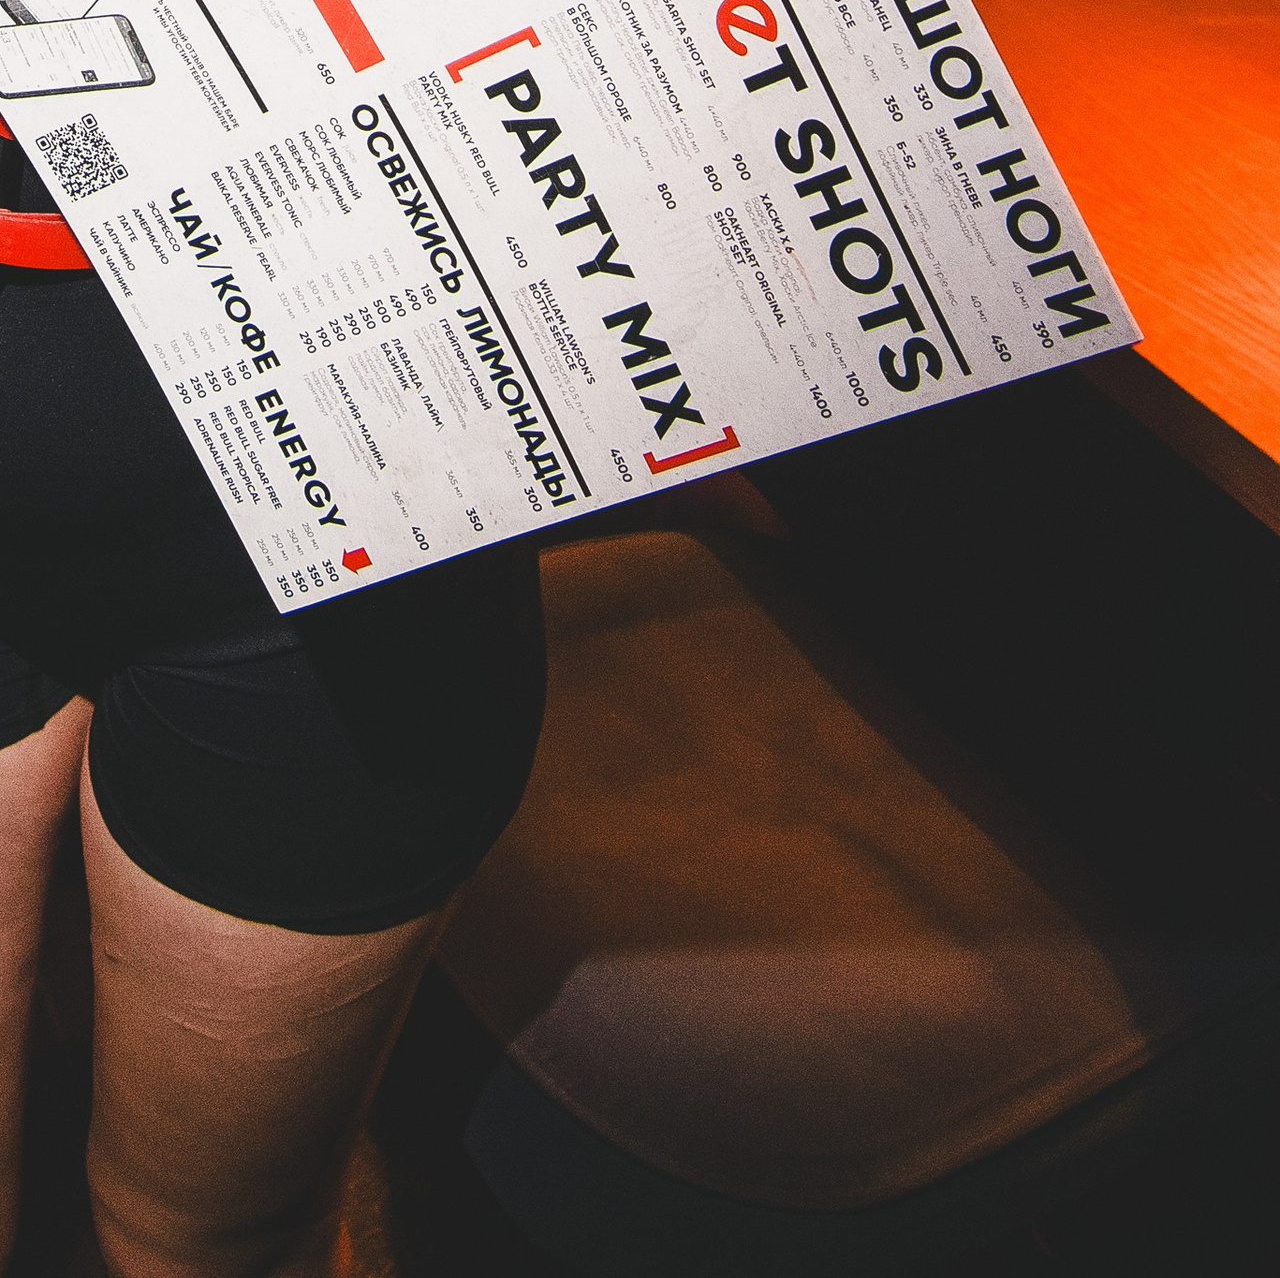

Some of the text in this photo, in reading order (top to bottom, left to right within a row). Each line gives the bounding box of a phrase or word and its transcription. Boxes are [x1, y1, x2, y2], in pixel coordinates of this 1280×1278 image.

[577, 2, 598, 33] СЕКС
[156, 14, 170, 29] МЫ
[166, 28, 193, 66] УГОСТИМ
[189, 65, 204, 86] ТЕБЯ
[199, 85, 232, 133] КОКТЕЙЛЕМ
[316, 63, 336, 85] 650
[566, 6, 632, 123] В БОЛЬШОМ ГОРОДЕ
[682, 36, 705, 67] SHOT
[699, 68, 717, 89] SET
[417, 75, 454, 131] PARTY MIX
[913, 83, 934, 111] 330
[329, 117, 347, 140] СОК
[428, 70, 500, 197] VODKA HUSKY RED BULL
[268, 144, 301, 192] EVERVESS
[284, 137, 320, 192] СВЕЖАЧОК
[483, 68, 636, 279] PARTY
[731, 153, 752, 181] 900
[895, 140, 917, 171] Б-52
[934, 126, 984, 210] ЗИНА В ГНЕВЕ
[351, 103, 465, 294] ОСВЕЖИСЬ
[657, 182, 677, 210] 800
[116, 214, 139, 243] ЛАТТЕ
[131, 208, 170, 265] АМЕРИКАНО
[713, 210, 747, 265] SHOT SET
[759, 192, 786, 234] ХАСКИ
[784, 246, 795, 255] 6
[975, 147, 1112, 339] НОГИ
[505, 236, 528, 269] 4500
[724, 207, 787, 329] OAKHEART ORIGINAL
[774, 118, 944, 393] SHOTS
[372, 299, 392, 324] 500
[420, 282, 437, 305] 150
[358, 306, 377, 330] 250
[1032, 320, 1055, 349] 390
[438, 318, 493, 411] ГРЕЙПФРУТОВЫЙ
[601, 301, 706, 441] MIX
[990, 334, 1012, 363] 450
[204, 369, 222, 393] 250
[809, 383, 833, 419] 1400
[845, 370, 870, 407] 1000
[238, 399, 266, 445] RED BULL
[326, 363, 387, 471] МАРАКУЙЯ-МАЛИНА
[456, 305, 577, 508] ЛИМОНАДЫ
[193, 418, 244, 504] ADRENALINE RUSH
[254, 388, 347, 527] ENERGY
[523, 486, 543, 513] 300
[411, 526, 430, 551] 400
[276, 574, 294, 598] 350
[321, 558, 340, 583] 350
